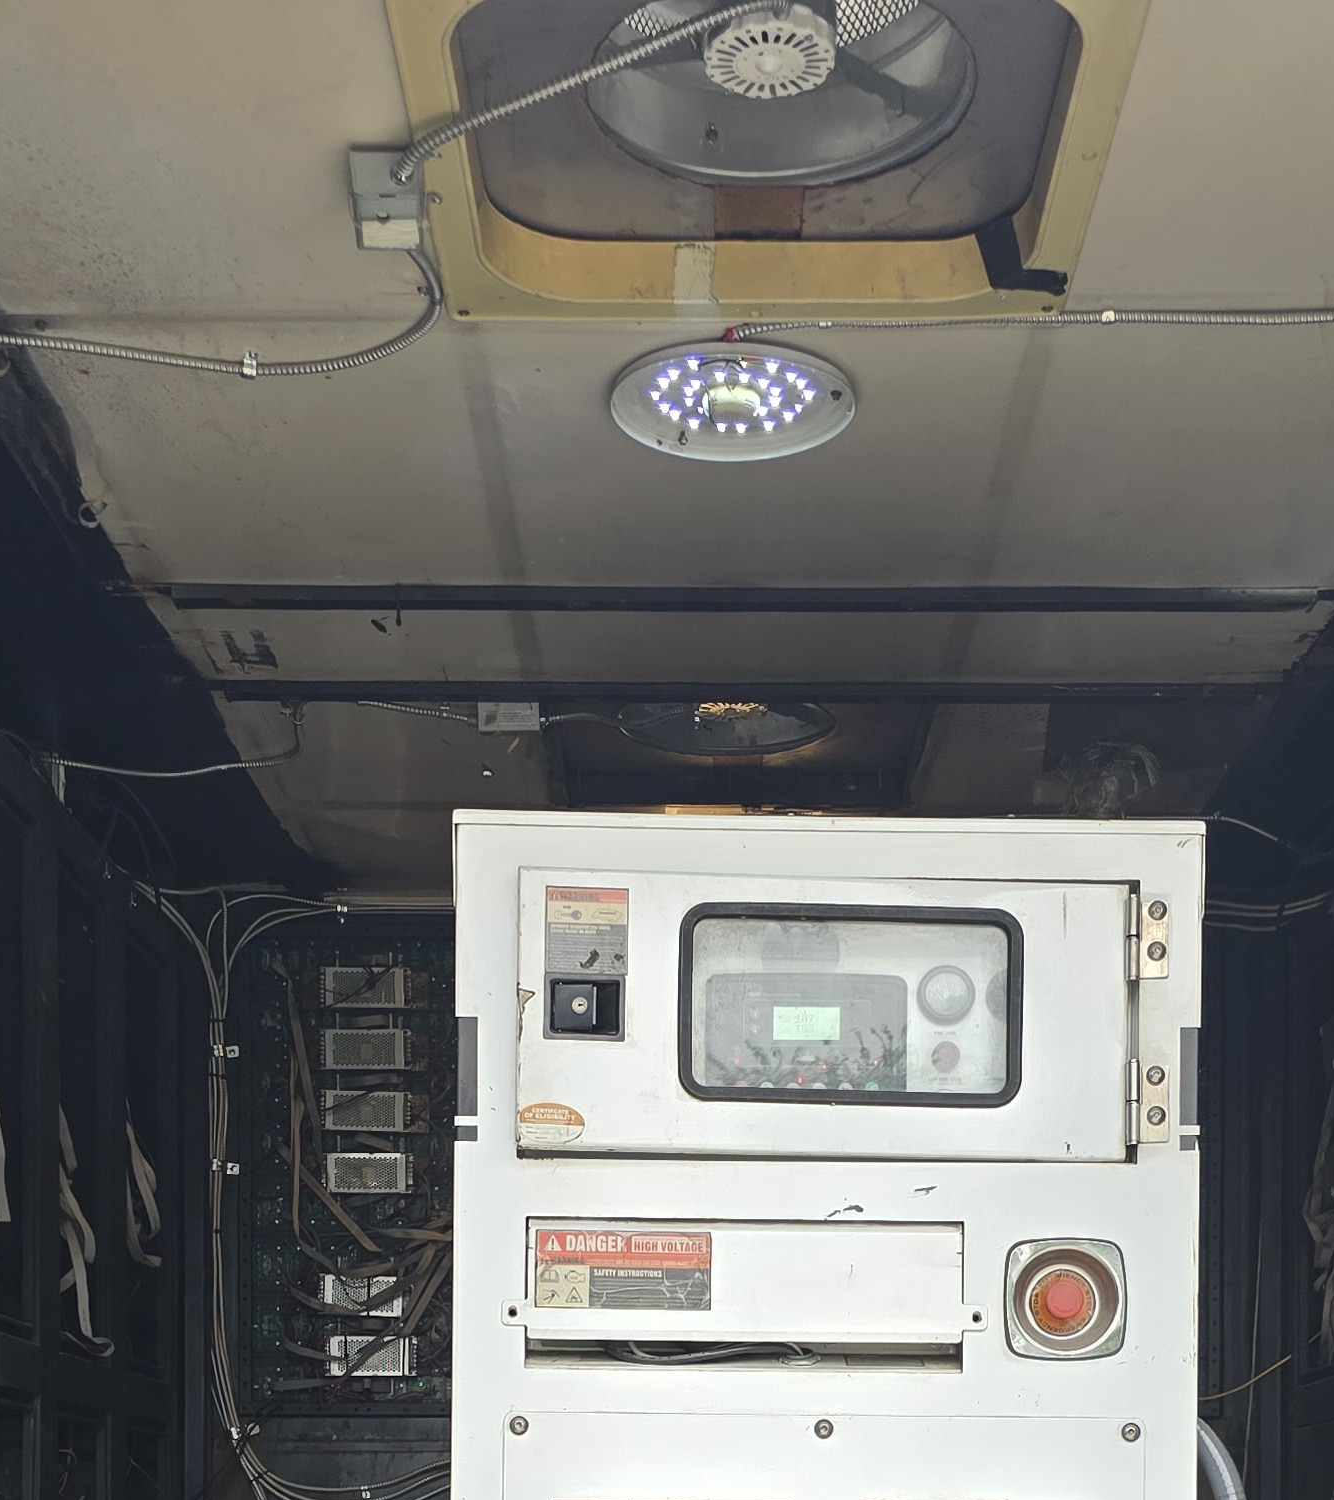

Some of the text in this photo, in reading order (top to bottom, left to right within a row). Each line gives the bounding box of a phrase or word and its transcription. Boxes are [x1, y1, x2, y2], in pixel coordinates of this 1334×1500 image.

[535, 1113, 576, 1121] ELIGIBILITY
[566, 1235, 704, 1252] DANGER HIGH VOLTAGE
[593, 1269, 663, 1278] SAFETY INSTRUCTIONS
